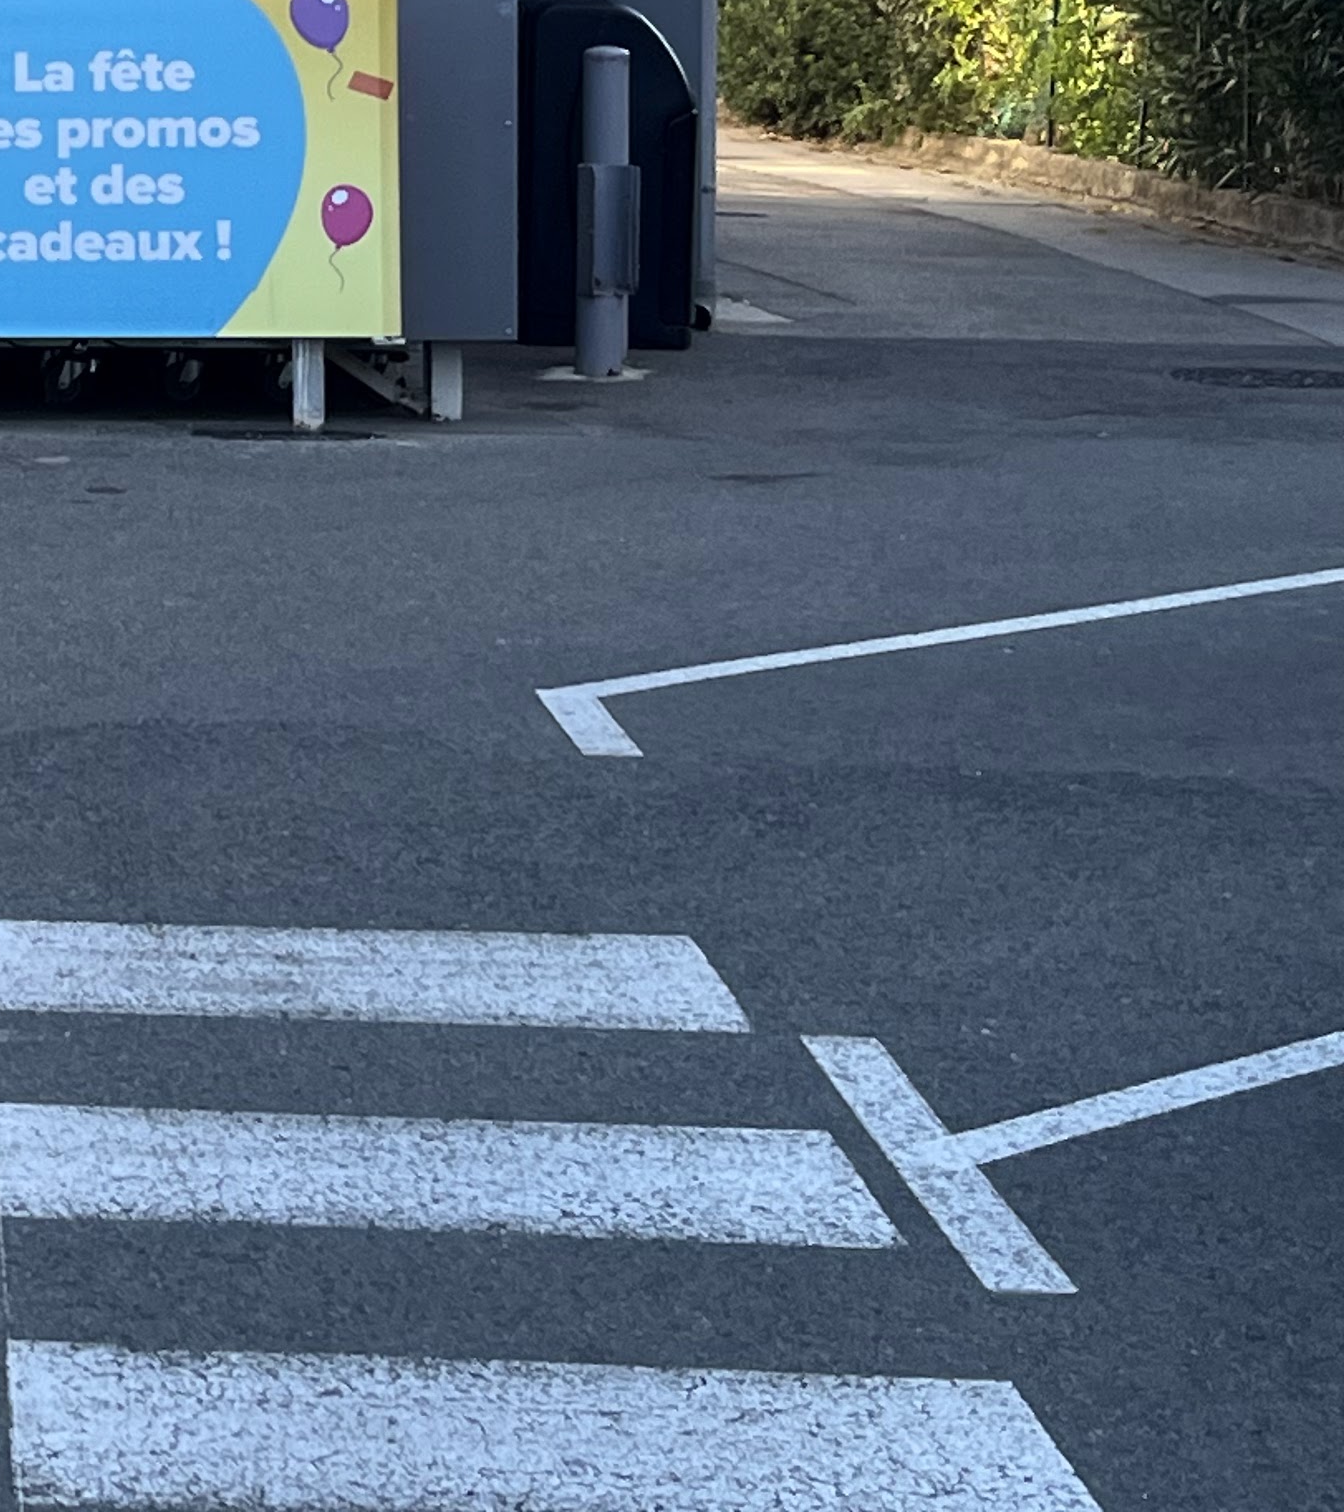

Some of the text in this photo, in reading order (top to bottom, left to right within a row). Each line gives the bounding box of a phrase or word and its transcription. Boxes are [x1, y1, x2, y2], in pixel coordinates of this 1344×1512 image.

[14, 49, 196, 92] La fête
[57, 114, 261, 158] promos
[24, 164, 185, 204] et des
